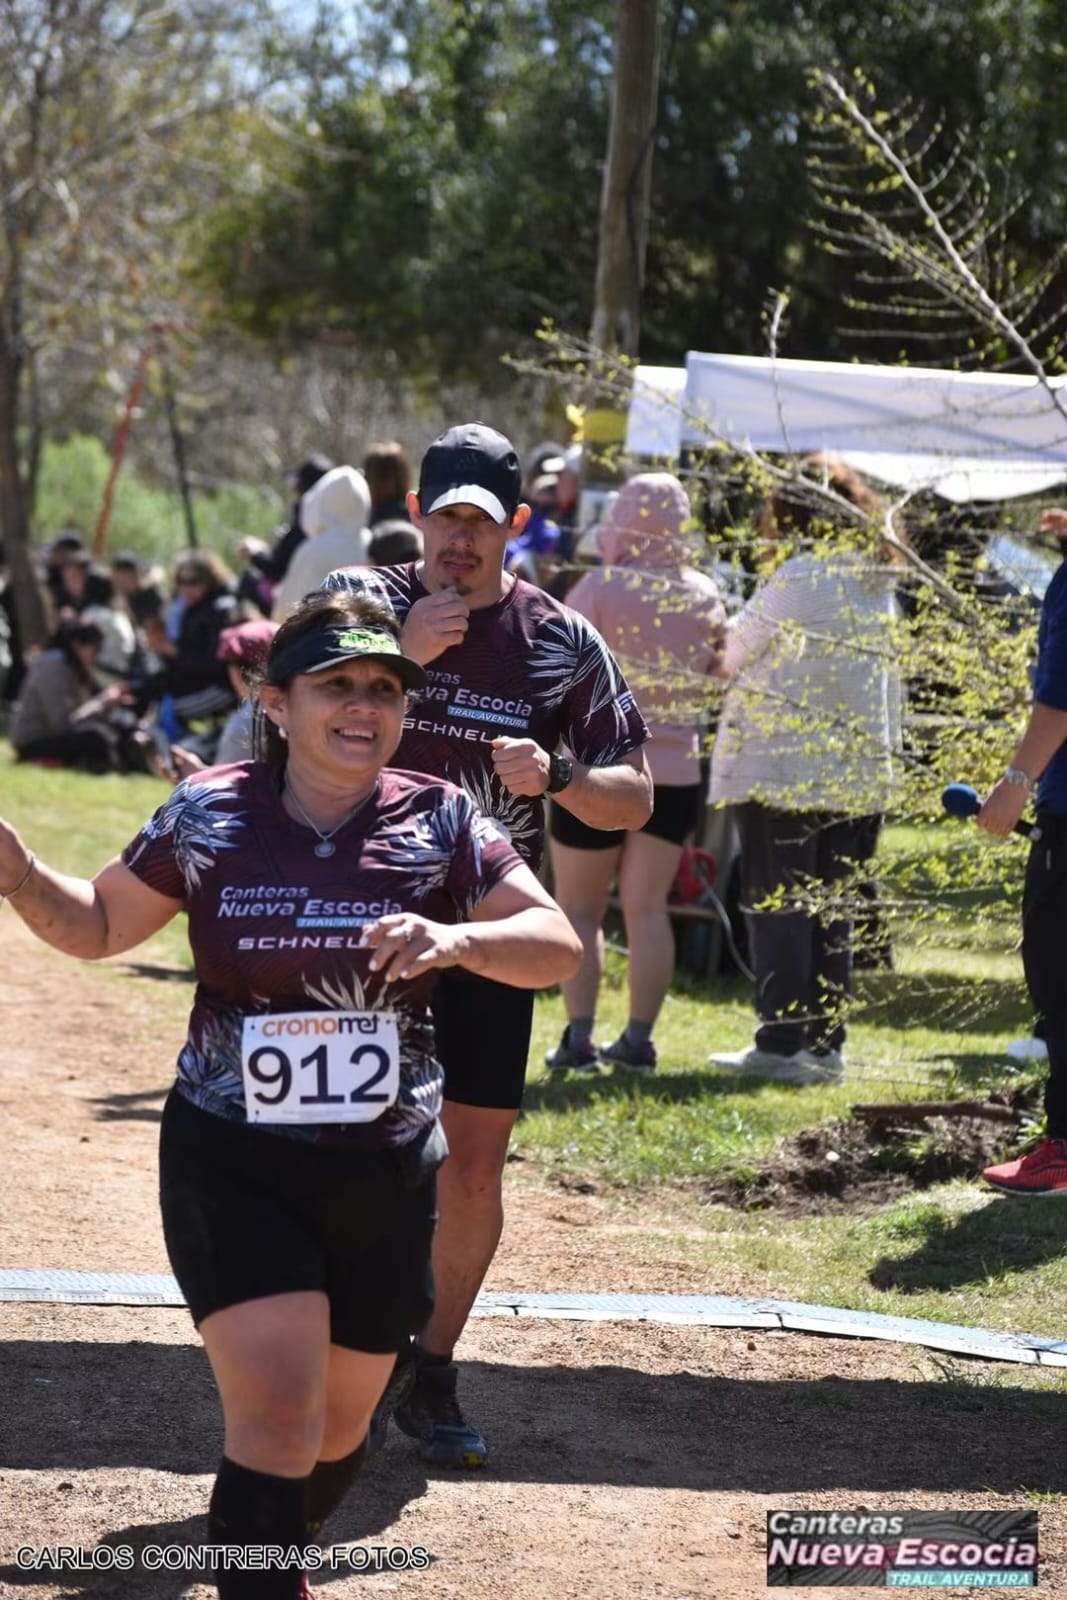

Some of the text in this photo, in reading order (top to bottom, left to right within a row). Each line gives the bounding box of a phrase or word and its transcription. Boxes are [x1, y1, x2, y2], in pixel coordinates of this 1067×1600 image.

[426, 670, 461, 685] eras
[454, 687, 533, 717] Escocia
[450, 706, 528, 729] TRAIL AVENTURA
[401, 718, 501, 743] SCHNEL
[220, 885, 309, 900] Canteras
[217, 898, 402, 918] Nueva Escocia
[238, 936, 379, 950] SCHNEL
[262, 1014, 380, 1037] cronomet
[248, 1044, 391, 1105] 912
